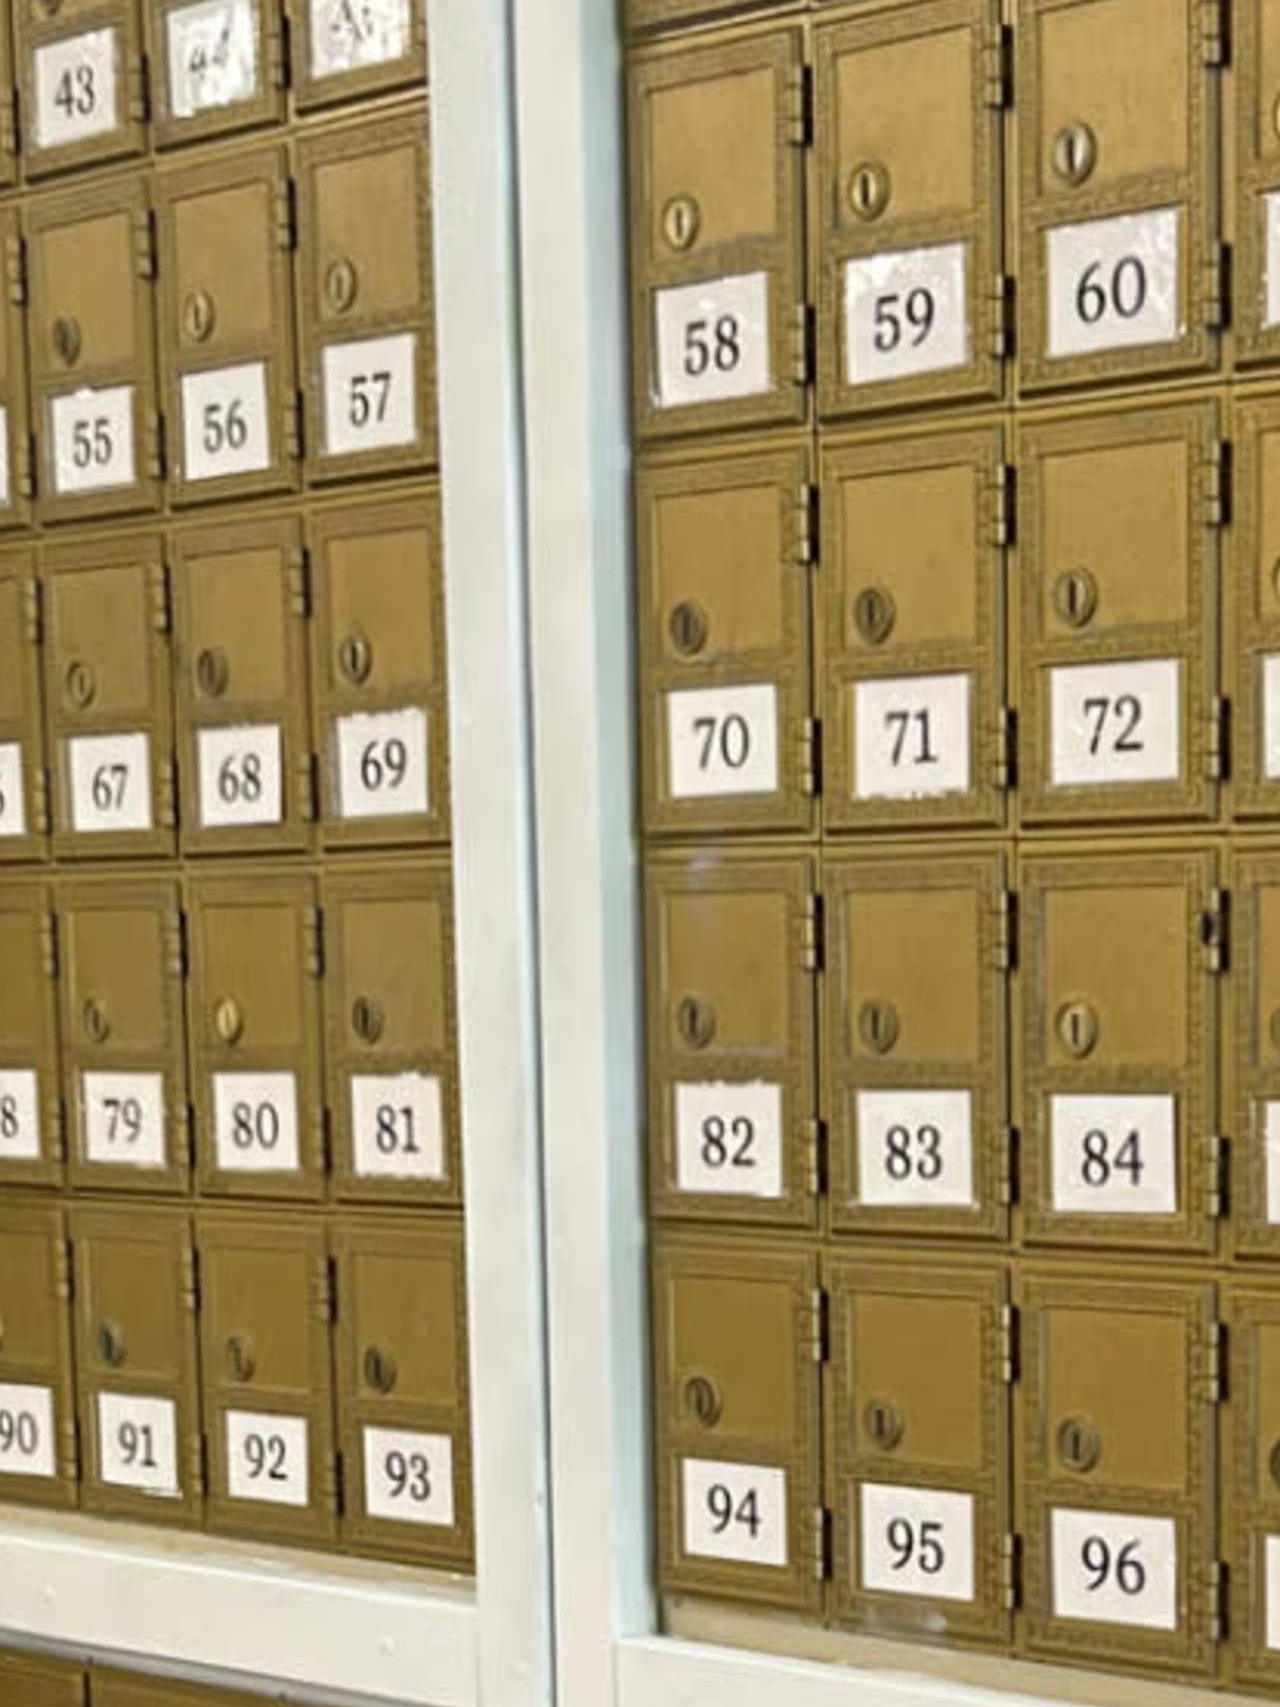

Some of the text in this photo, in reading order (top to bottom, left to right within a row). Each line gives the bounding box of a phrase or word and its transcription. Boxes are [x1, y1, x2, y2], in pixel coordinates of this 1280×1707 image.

[53, 65, 96, 118] 43
[1075, 255, 1147, 324] 60
[684, 314, 740, 377] 58
[873, 287, 935, 353] 59
[203, 398, 248, 454] 56
[349, 370, 392, 428] 57
[72, 416, 113, 469] 55
[692, 713, 750, 770] 70
[884, 707, 938, 767] 71
[1083, 694, 1144, 756] 72
[91, 762, 129, 810] 67
[217, 752, 262, 803] 68
[360, 738, 407, 792] 69
[101, 1097, 143, 1144] 79
[231, 1101, 280, 1150] 80
[375, 1104, 420, 1154] 81
[701, 1115, 756, 1168] 82
[884, 1124, 943, 1181] 83
[1081, 1129, 1144, 1187] 84
[117, 1421, 158, 1468] 91
[243, 1433, 289, 1482] 92
[384, 1450, 431, 1502] 93
[706, 1483, 761, 1538] 94
[886, 1518, 945, 1574] 95
[1081, 1536, 1146, 1596] 96
